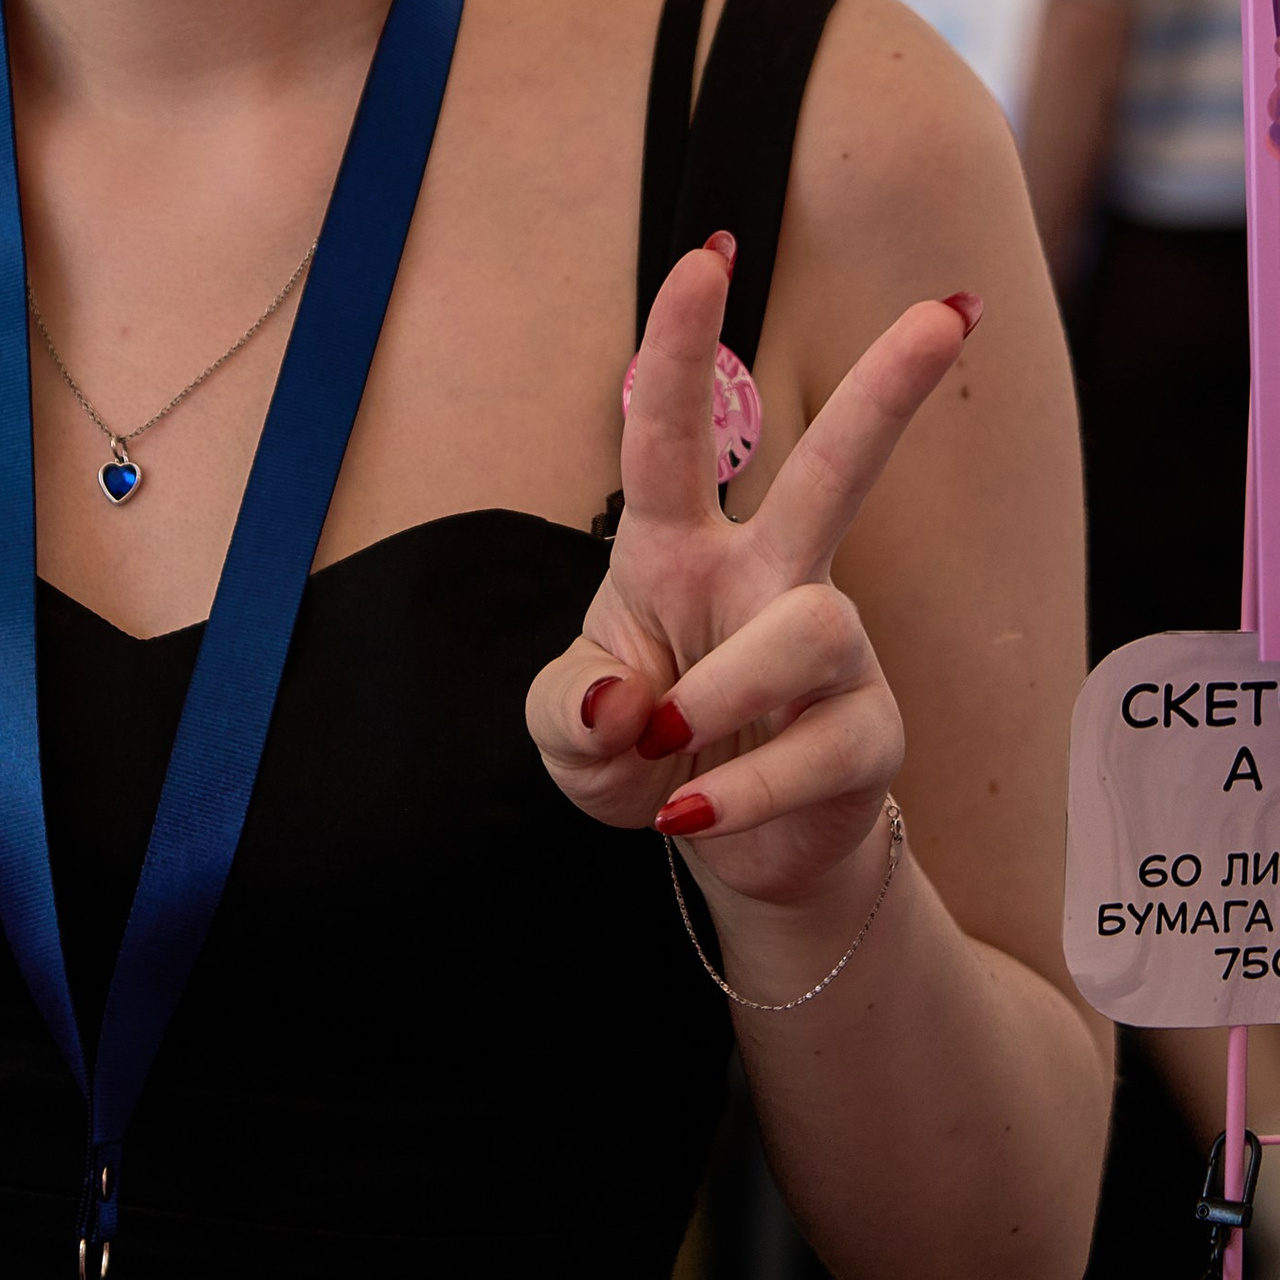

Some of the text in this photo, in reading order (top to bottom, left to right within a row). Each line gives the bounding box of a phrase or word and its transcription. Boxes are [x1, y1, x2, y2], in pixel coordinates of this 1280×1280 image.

[1121, 680, 1279, 730] СКЕТ
[1138, 851, 1280, 888] 60 ЛИ
[1097, 898, 1274, 937] БУМАГА
[1213, 945, 1280, 981] 75
